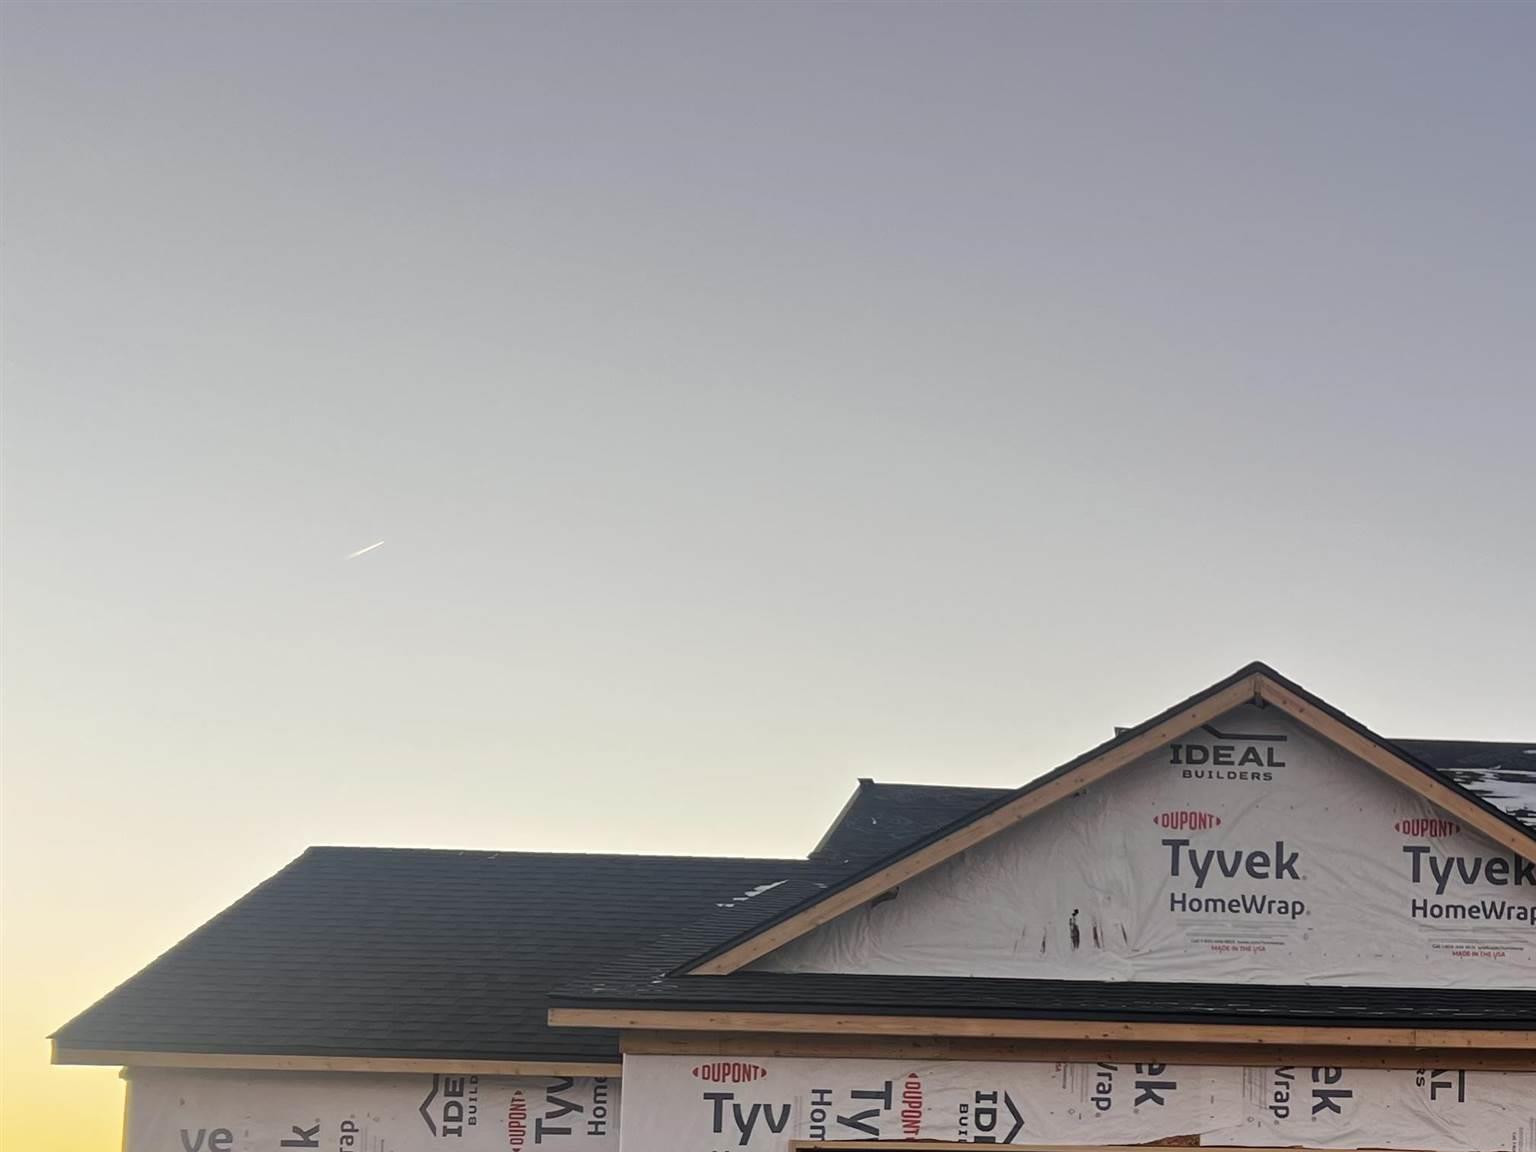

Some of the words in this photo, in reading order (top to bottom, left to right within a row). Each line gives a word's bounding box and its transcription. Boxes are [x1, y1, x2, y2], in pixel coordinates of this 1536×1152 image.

[1169, 744, 1286, 768] IDEAL
[1182, 769, 1273, 781] BUILDERS
[1161, 811, 1214, 830] DUPONT
[1402, 819, 1454, 837] DUPONT
[1162, 839, 1300, 889] Tyvek
[1170, 892, 1305, 919] HomeWrap
[702, 1062, 760, 1083] DUPONT
[508, 1096, 527, 1146] DUPONT
[901, 1082, 923, 1136] DUPONT
